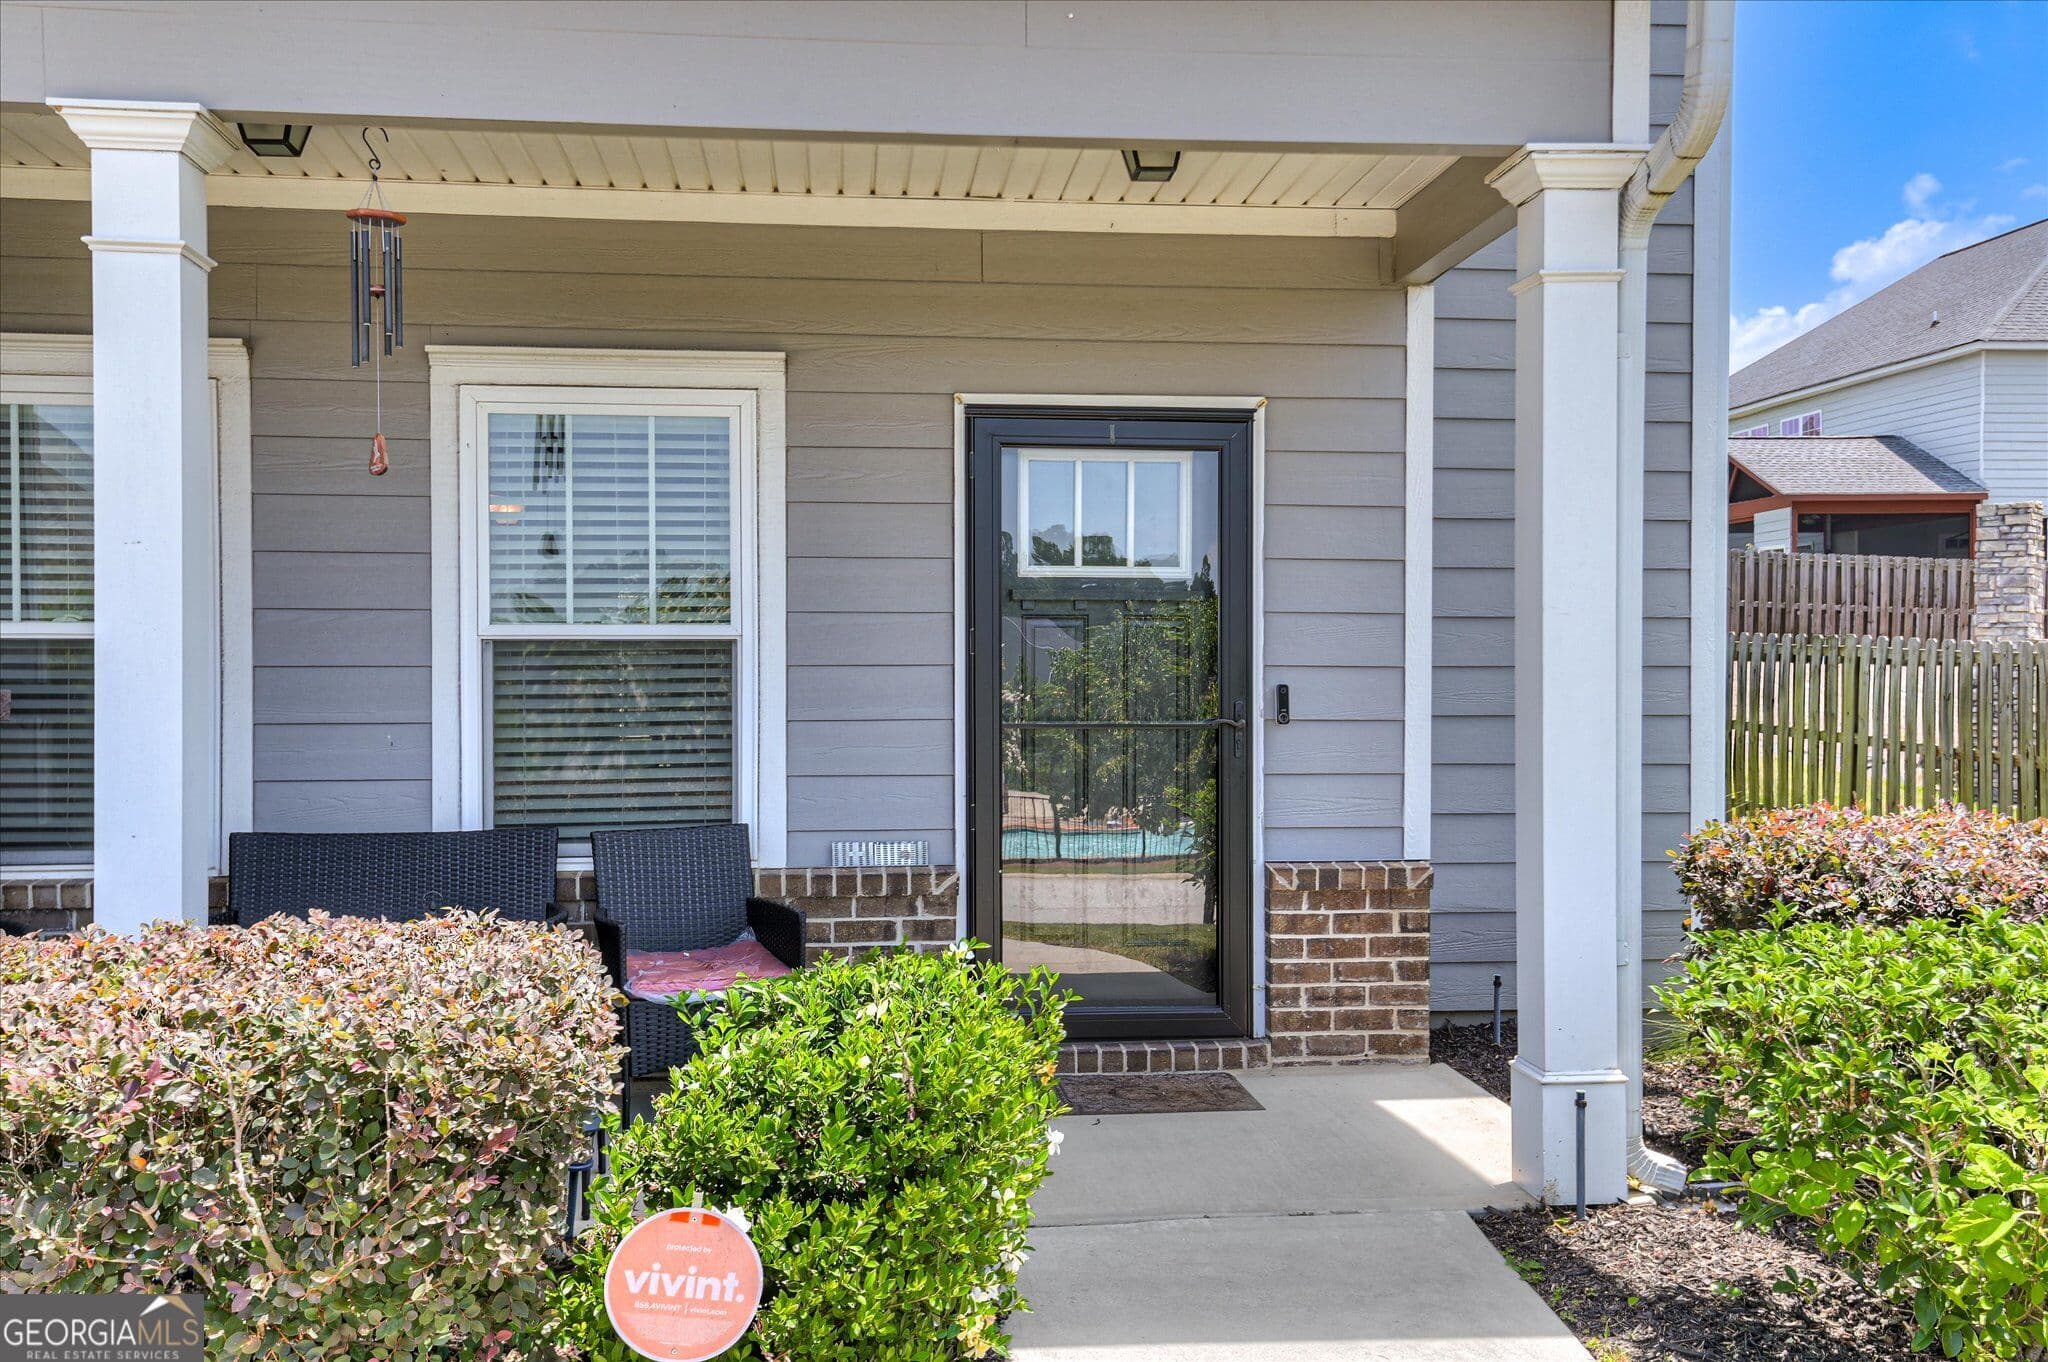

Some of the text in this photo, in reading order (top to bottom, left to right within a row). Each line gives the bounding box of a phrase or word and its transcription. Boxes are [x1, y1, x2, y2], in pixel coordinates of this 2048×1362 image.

[665, 1243, 712, 1255] protected by
[624, 1261, 745, 1303] vivint.
